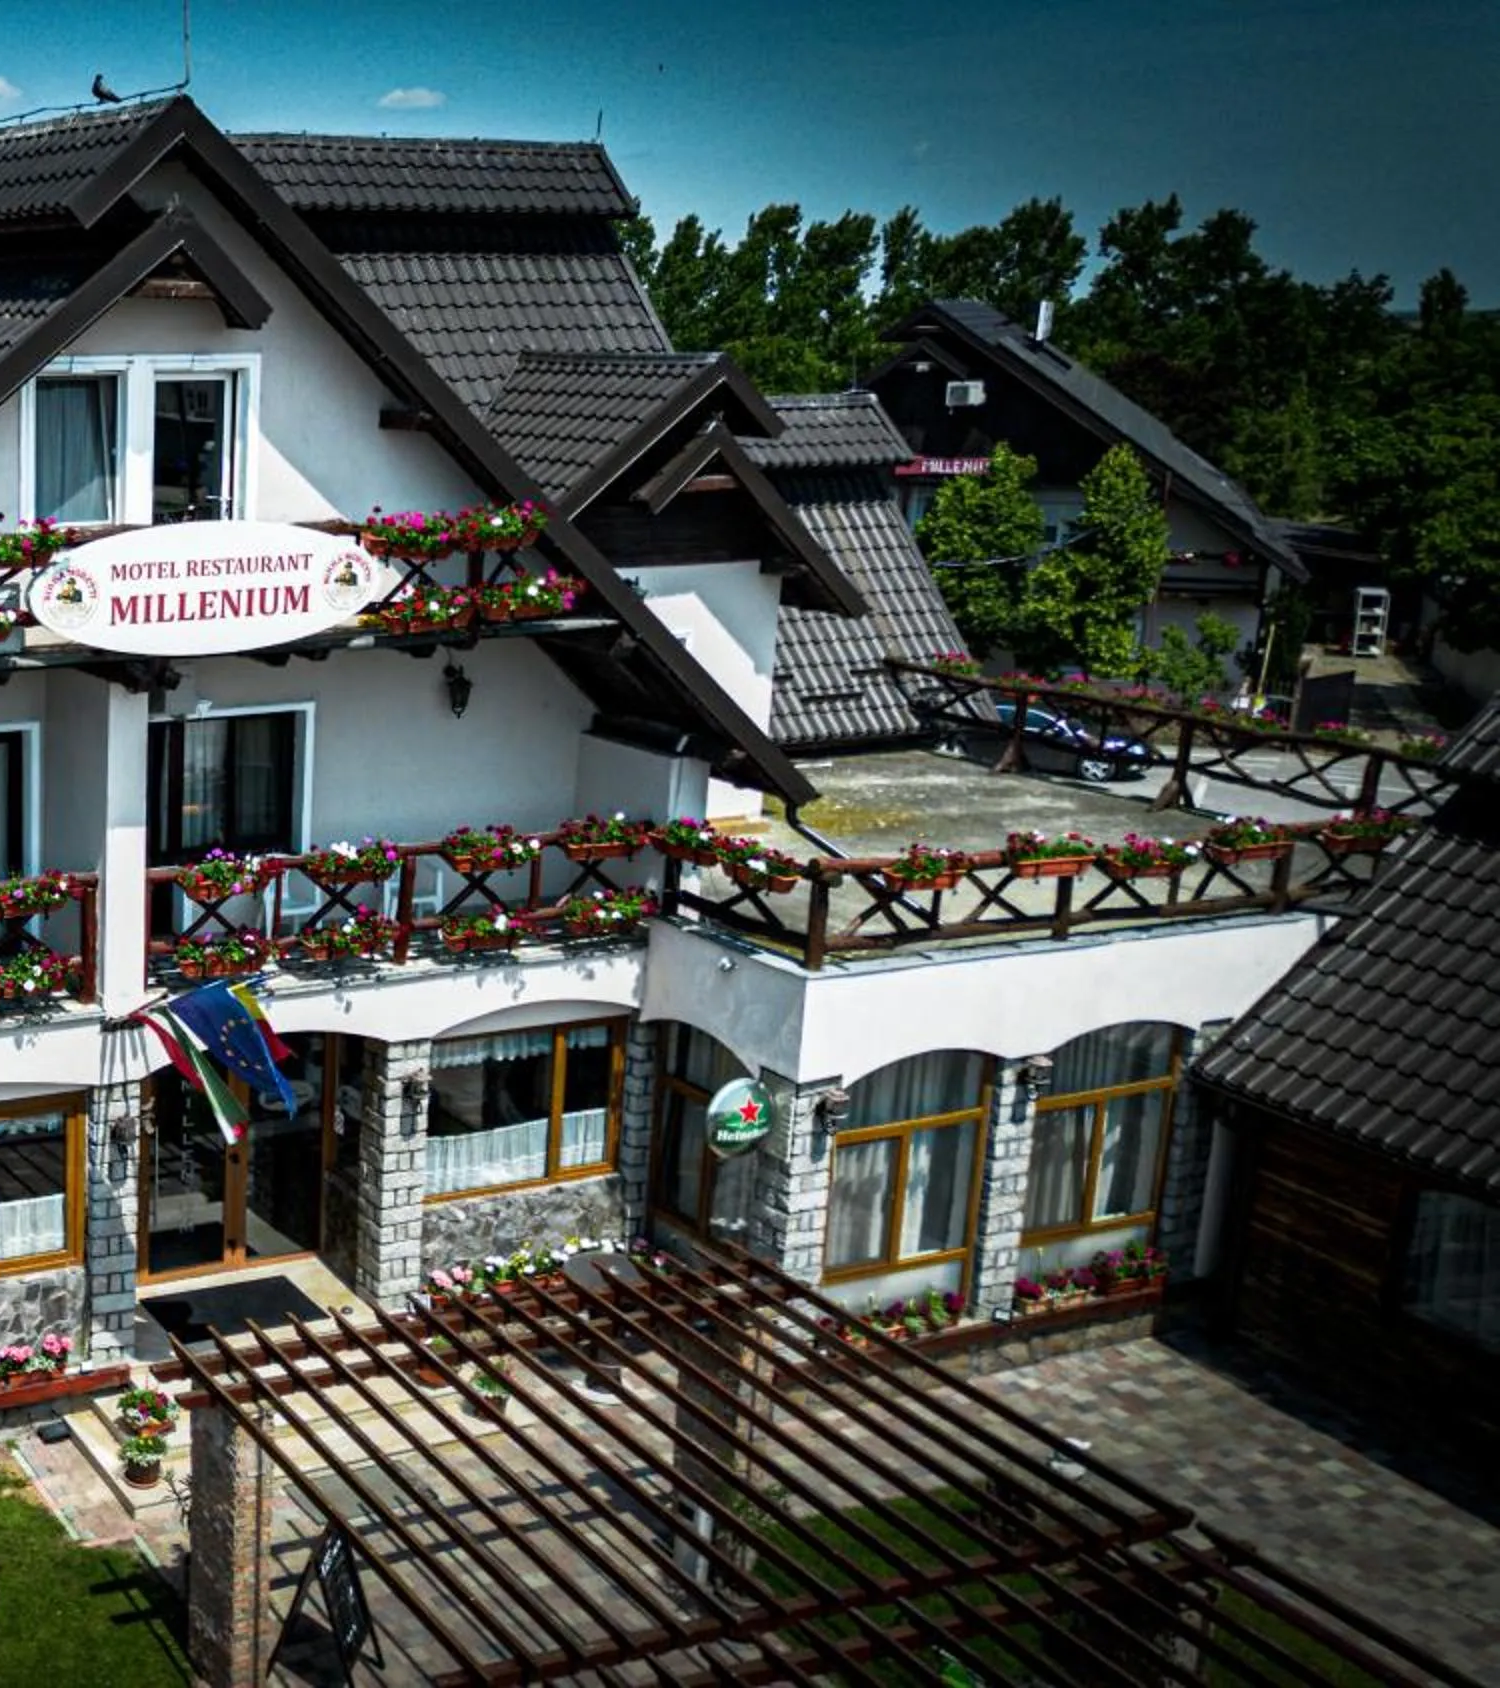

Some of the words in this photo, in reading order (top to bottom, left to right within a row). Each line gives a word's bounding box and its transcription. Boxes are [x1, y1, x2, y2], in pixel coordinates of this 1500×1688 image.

[110, 561, 180, 581] MOTEL
[186, 553, 313, 577] RESTAURANT
[109, 584, 310, 626] MILLENIUM
